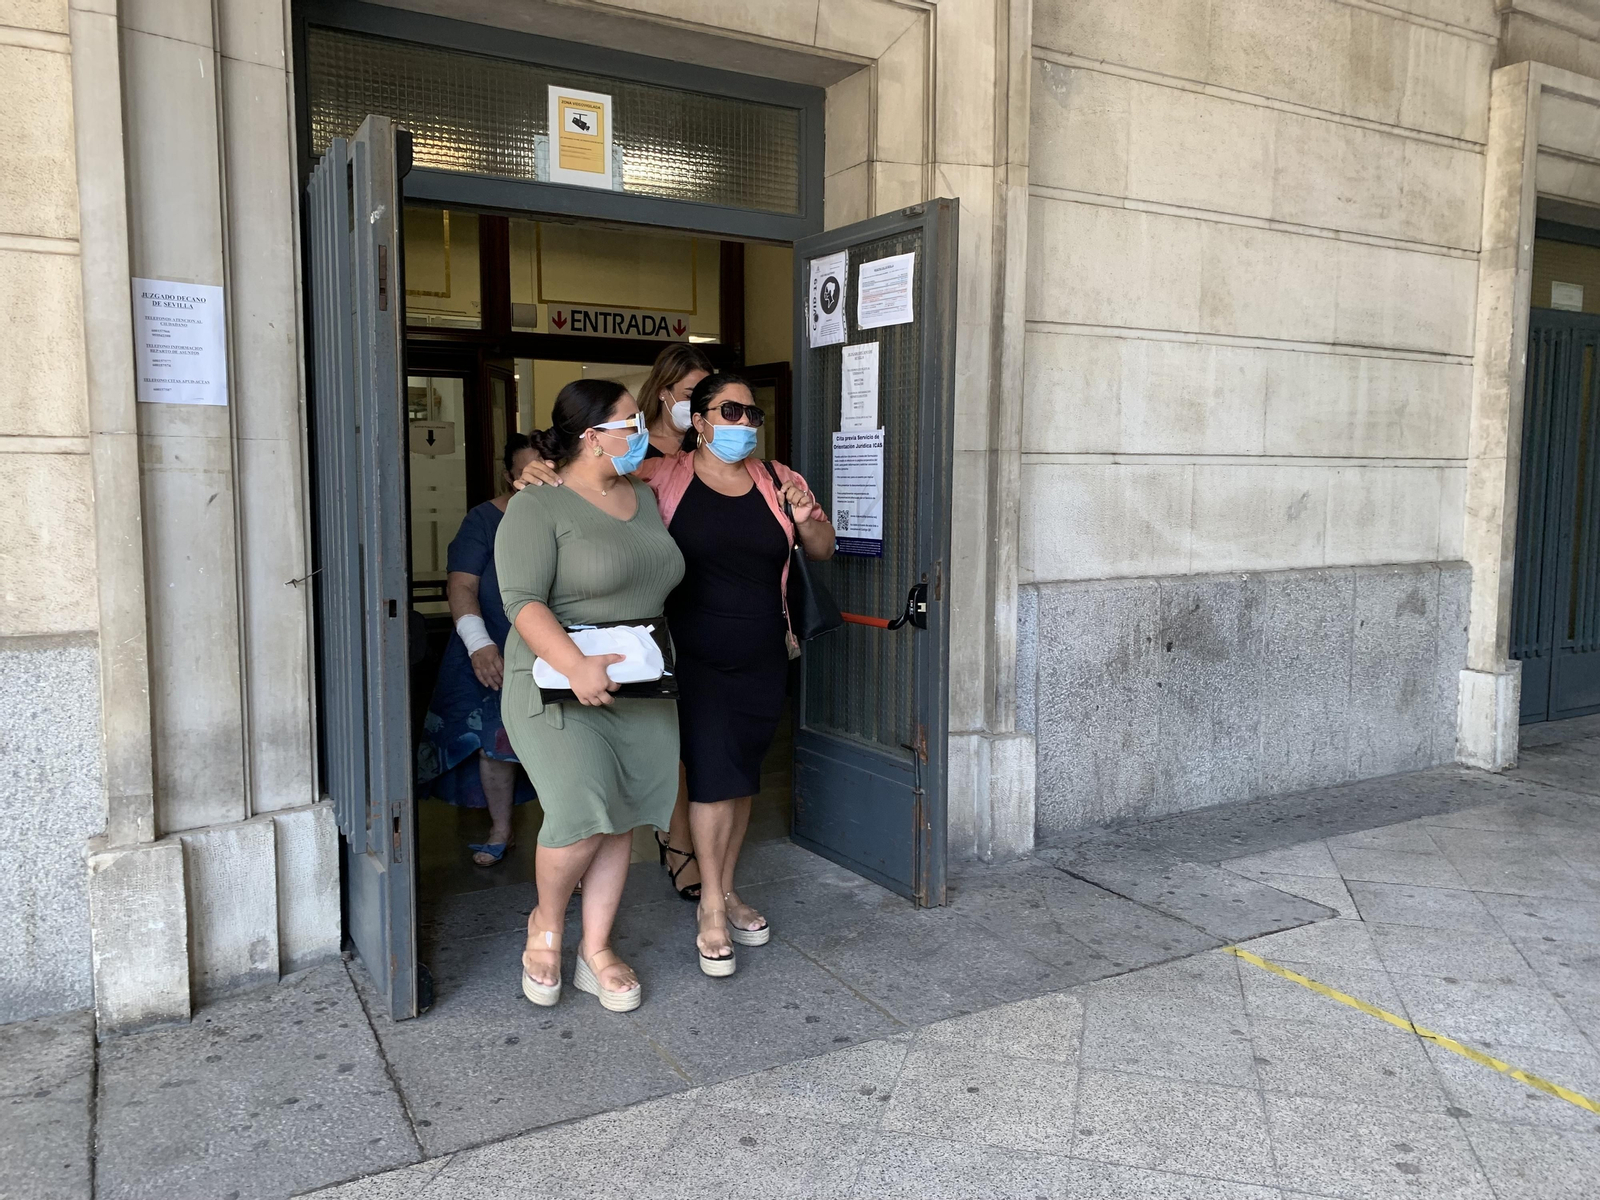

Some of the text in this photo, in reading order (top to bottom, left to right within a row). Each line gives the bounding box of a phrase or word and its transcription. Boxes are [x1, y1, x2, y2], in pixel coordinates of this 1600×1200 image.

[141, 292, 207, 303] JUZGADO DECANO
[163, 301, 194, 309] SEVILLA
[570, 309, 671, 338] ENTRADA
[845, 434, 857, 442] previa
[857, 433, 874, 441] Servicio
